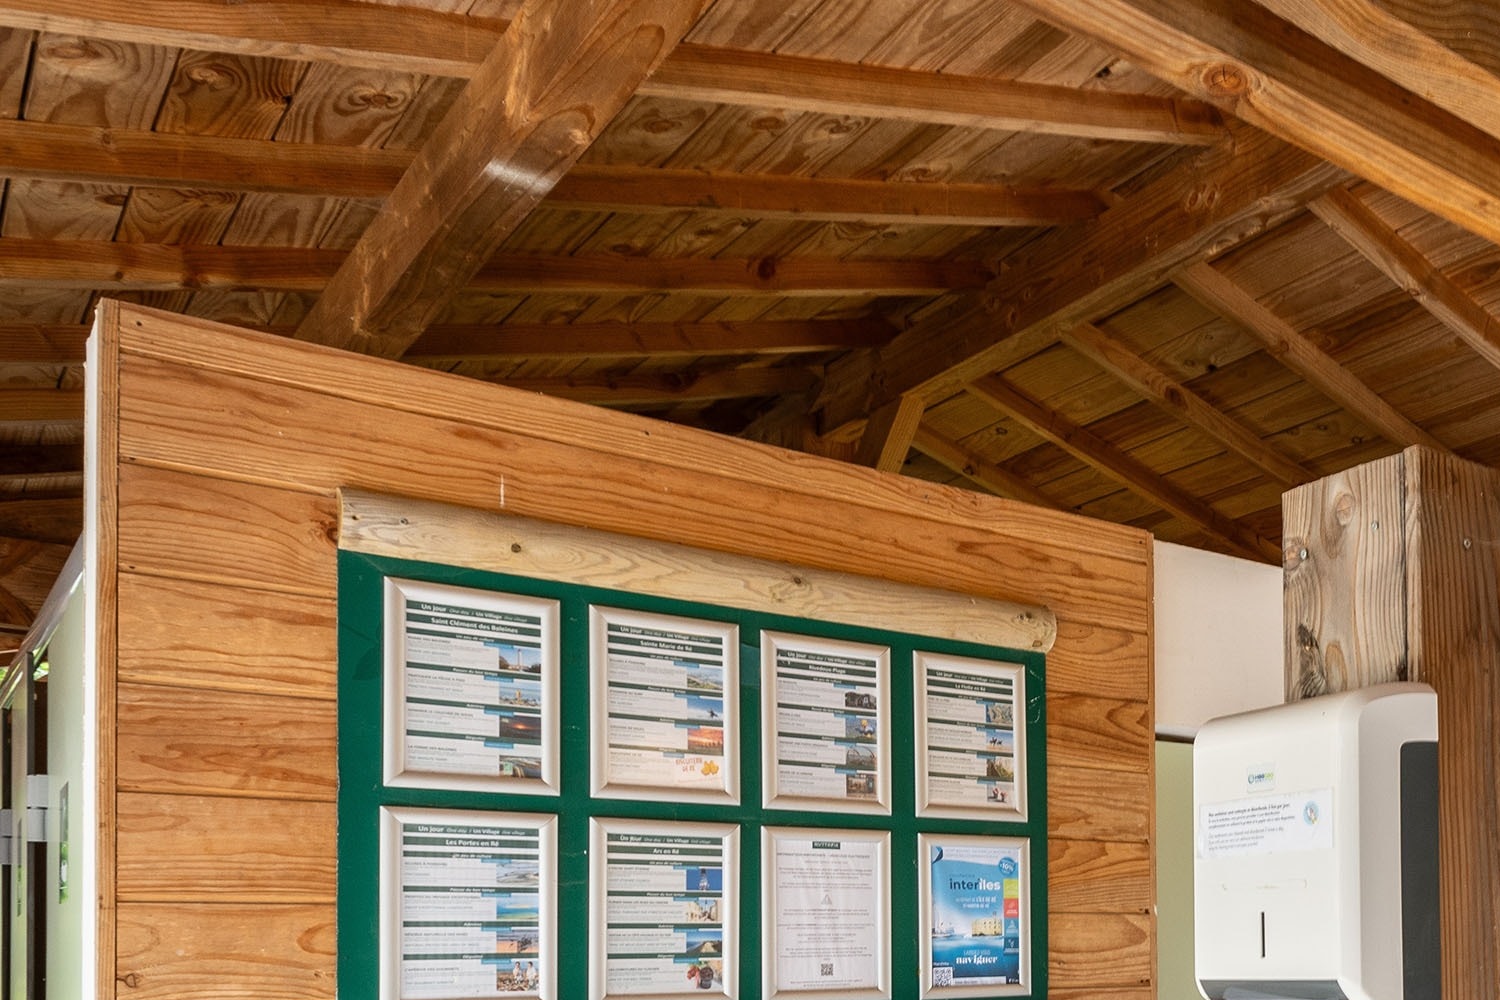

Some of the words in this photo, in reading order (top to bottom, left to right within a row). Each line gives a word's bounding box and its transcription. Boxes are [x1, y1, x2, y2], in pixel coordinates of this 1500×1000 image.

[431, 617, 448, 625] Saint
[450, 619, 478, 629] Clément
[478, 622, 490, 631] des
[491, 624, 518, 634] Baleines
[640, 640, 658, 648] Sainte
